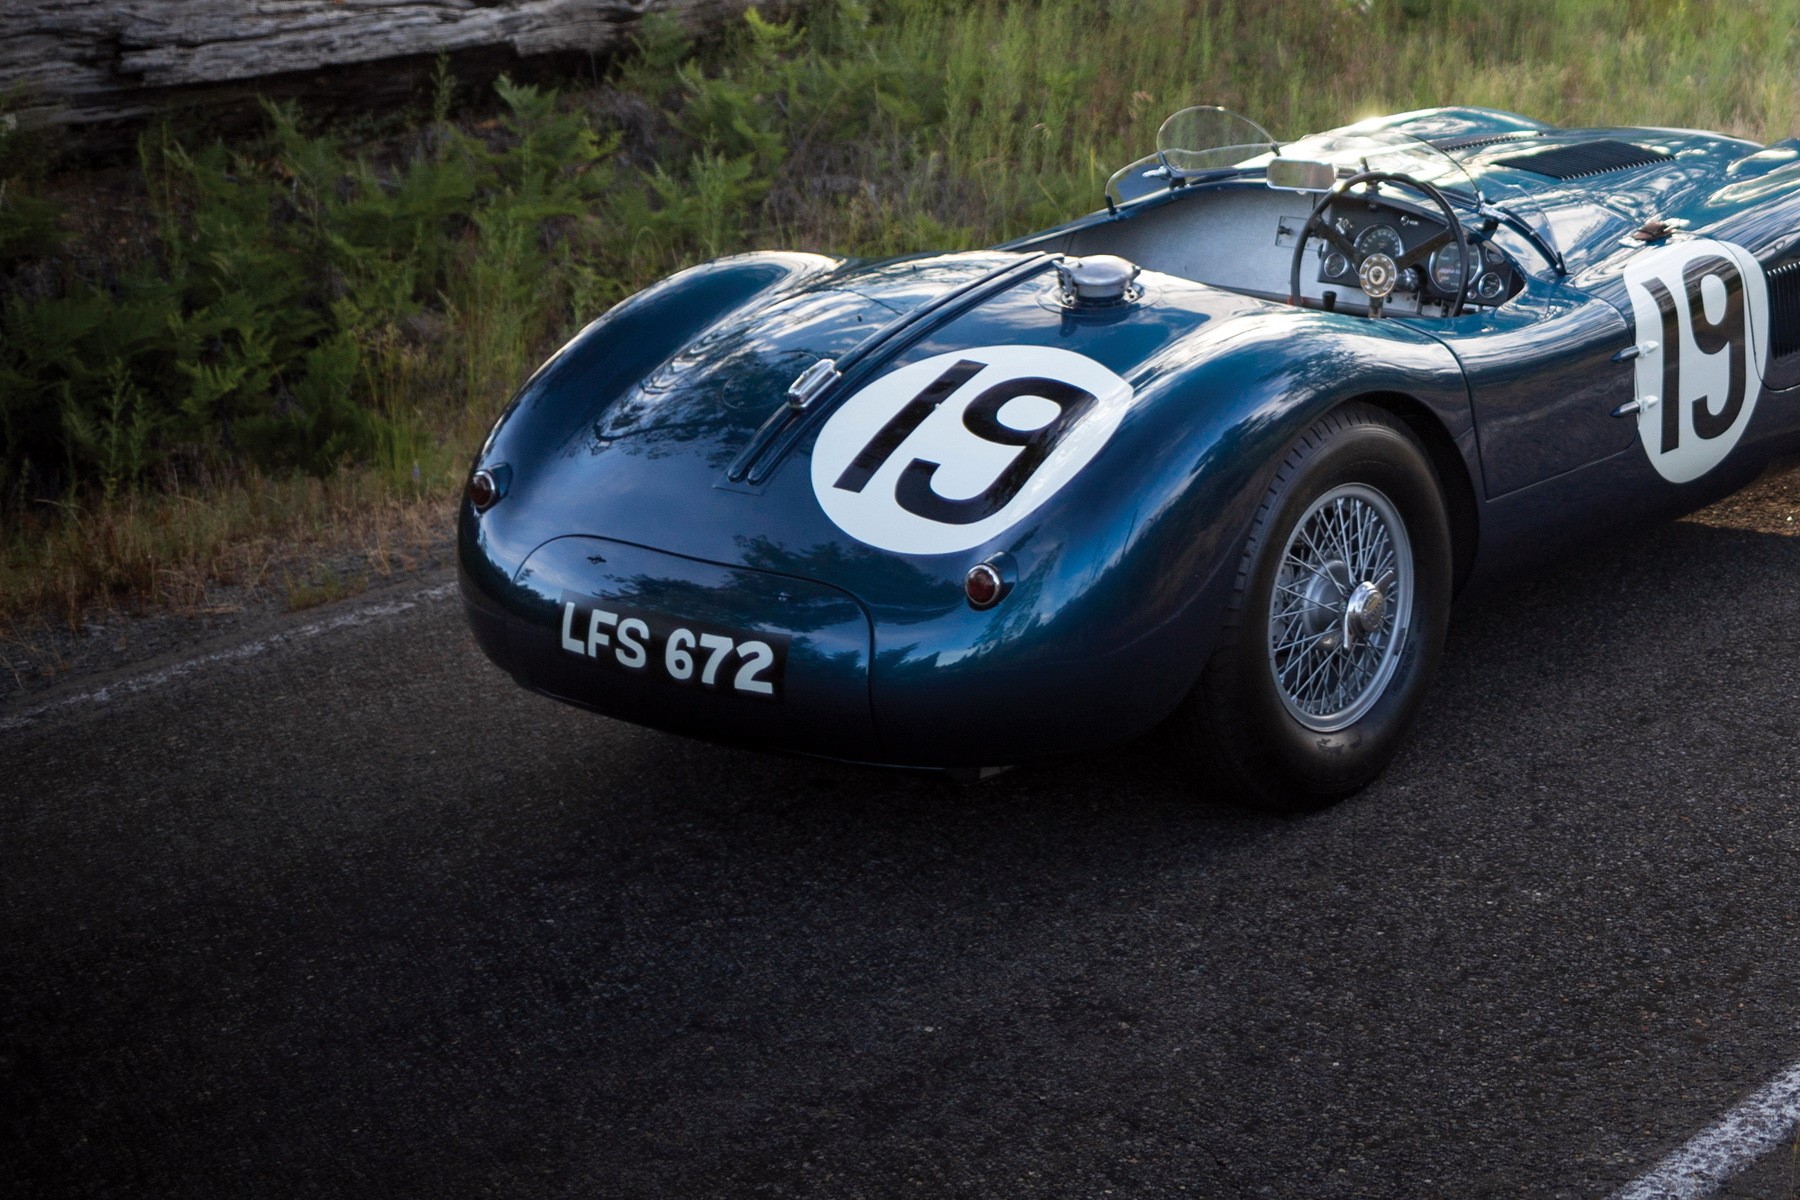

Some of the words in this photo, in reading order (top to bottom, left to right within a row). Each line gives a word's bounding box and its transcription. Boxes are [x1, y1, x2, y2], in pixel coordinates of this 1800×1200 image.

[1641, 254, 1746, 454] 19
[833, 359, 1098, 524] 19
[562, 602, 649, 668] LFS
[665, 628, 774, 694] 672
